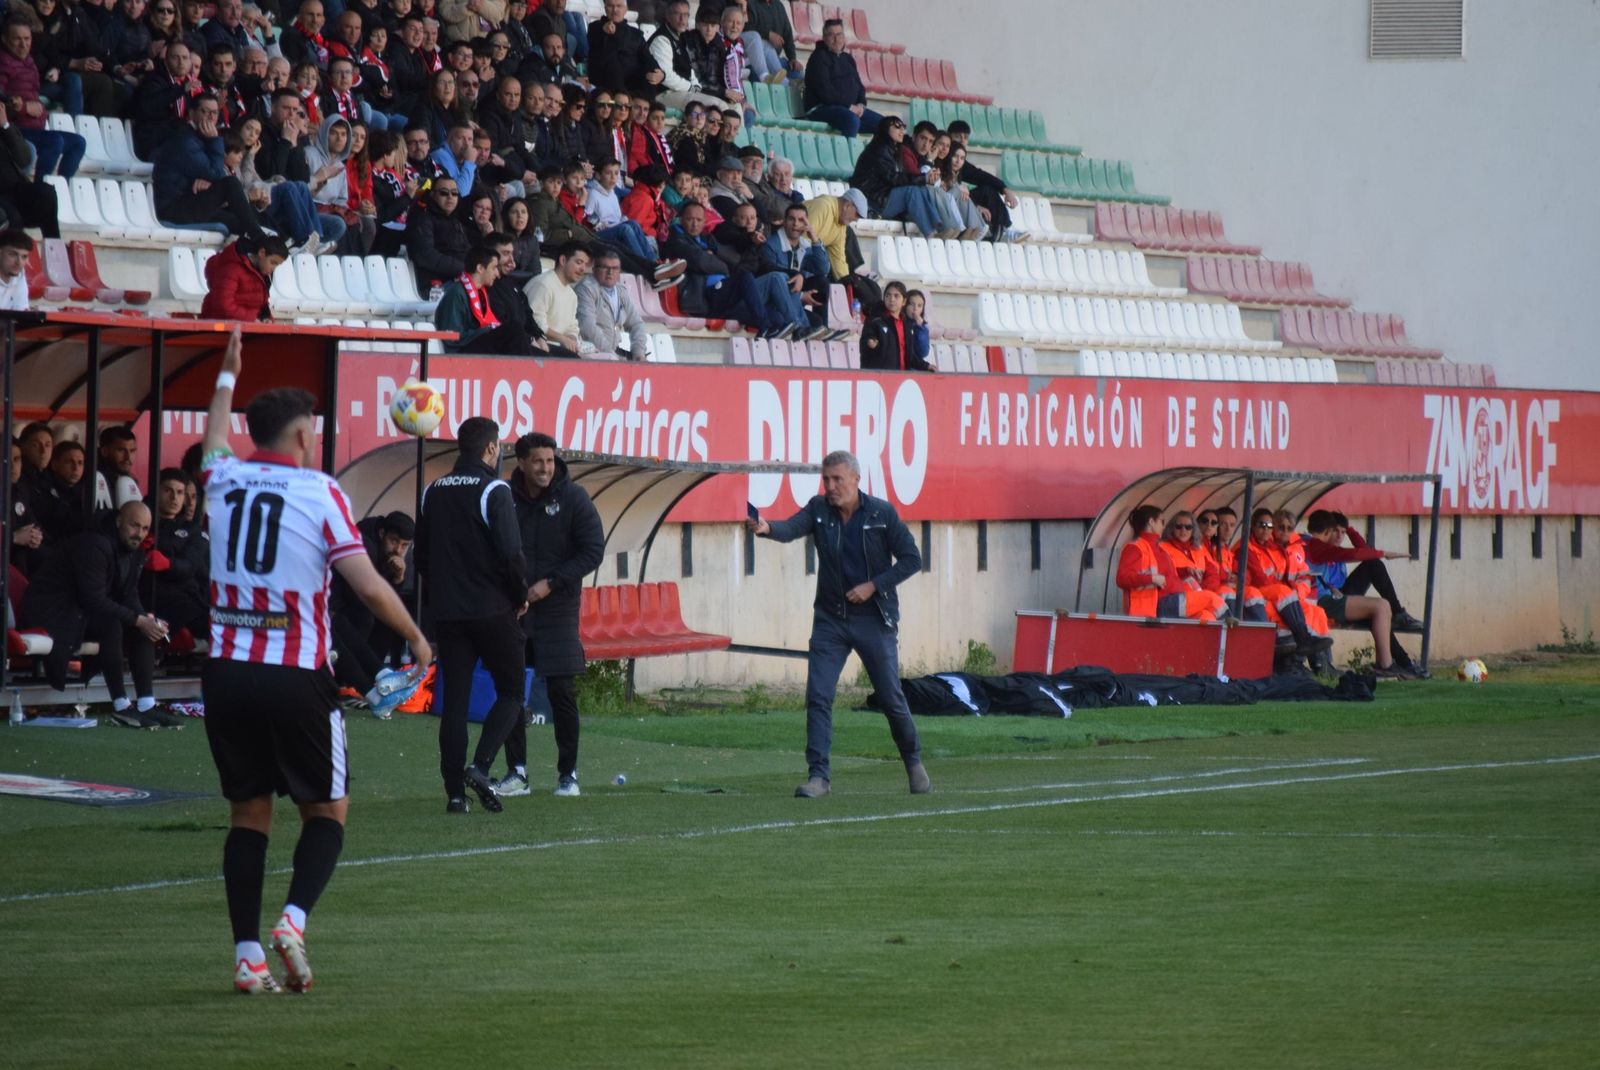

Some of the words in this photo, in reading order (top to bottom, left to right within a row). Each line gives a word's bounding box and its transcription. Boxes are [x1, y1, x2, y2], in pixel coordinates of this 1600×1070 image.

[377, 358, 534, 441] RTULOS
[960, 380, 1143, 449] FABRICACIÓN
[1168, 396, 1197, 448] DE
[1212, 397, 1290, 450] STAND
[434, 475, 481, 487] macron
[748, 378, 929, 508] DUERO
[224, 488, 285, 575] 10
